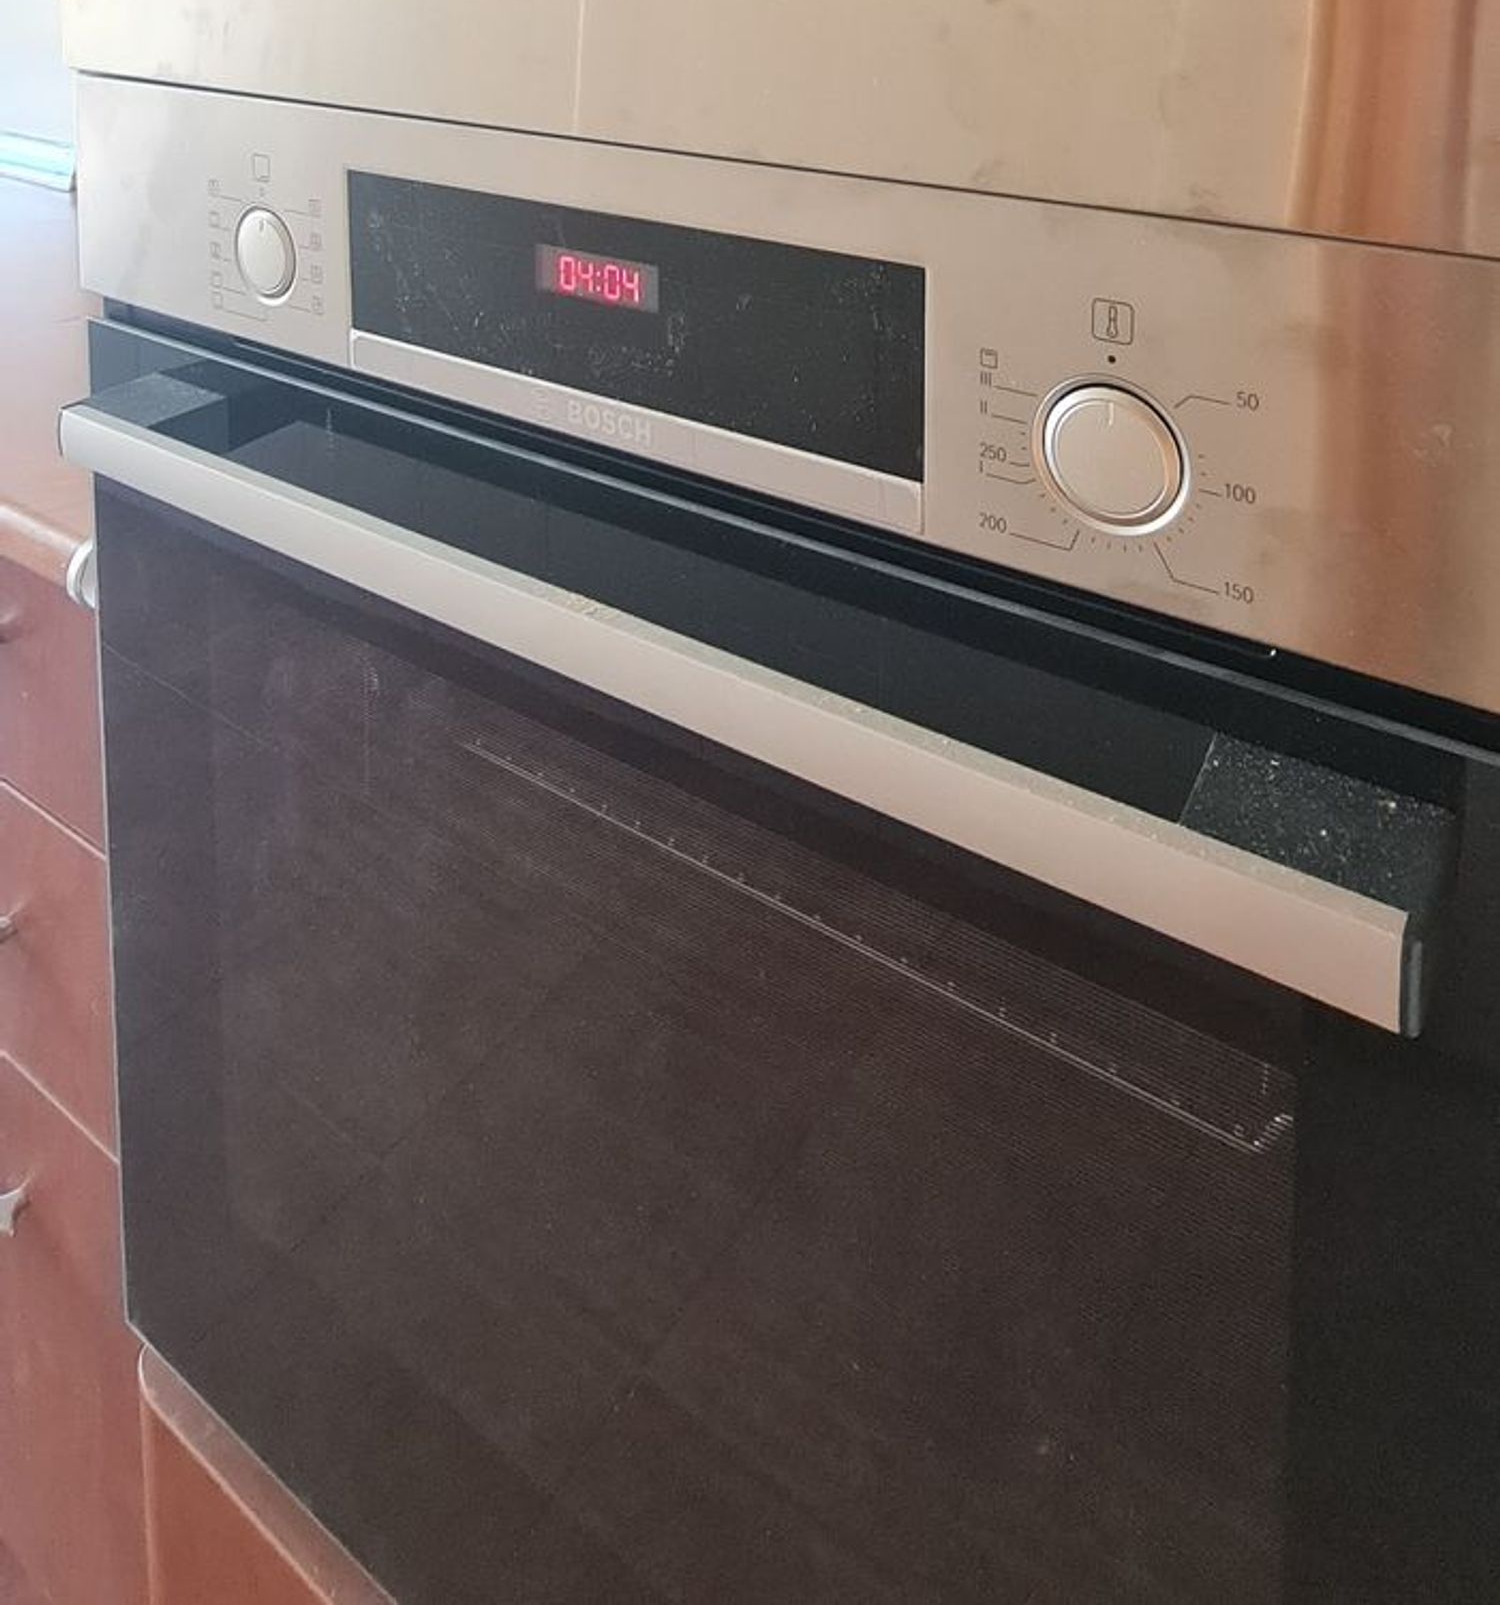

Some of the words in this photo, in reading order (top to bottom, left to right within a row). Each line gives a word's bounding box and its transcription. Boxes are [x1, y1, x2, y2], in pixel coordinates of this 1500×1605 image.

[559, 256, 640, 303] 04:04
[1236, 392, 1260, 412] 50
[566, 399, 650, 444] BOSCH
[979, 443, 1007, 464] 250
[1223, 483, 1256, 505] 100
[978, 513, 1008, 535] 200
[1223, 582, 1255, 605] 150
